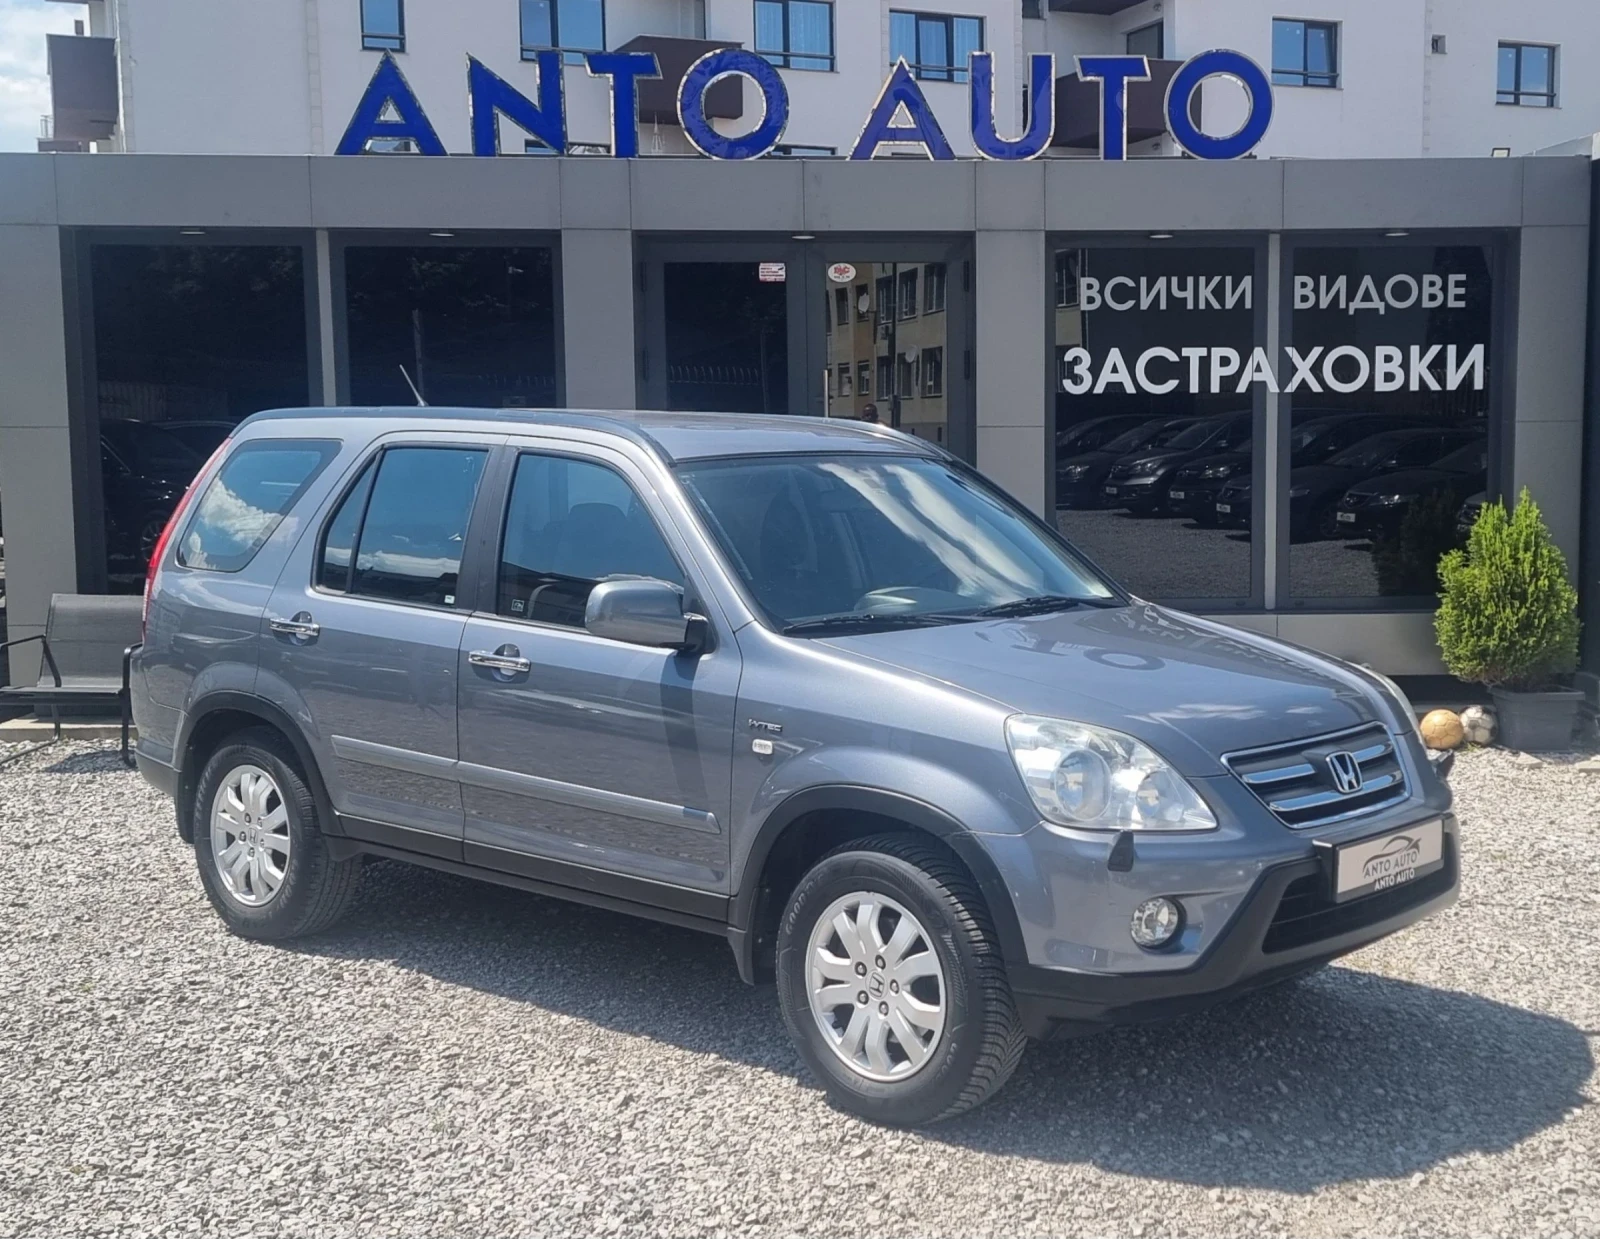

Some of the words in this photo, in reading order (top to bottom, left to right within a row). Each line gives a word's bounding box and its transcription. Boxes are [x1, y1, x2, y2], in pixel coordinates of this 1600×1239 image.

[334, 48, 789, 160] ANTO
[846, 49, 1275, 161] AUTO
[1080, 275, 1252, 311] ВСИЧКИ
[1293, 274, 1467, 315] ВИДОВЕ
[1062, 344, 1485, 395] ЗАСТРАХОВКИ
[1364, 859, 1391, 879] ANTO
[1394, 851, 1418, 868] AUTO
[1374, 876, 1395, 891] ANTO
[1396, 868, 1415, 883] AUTO
